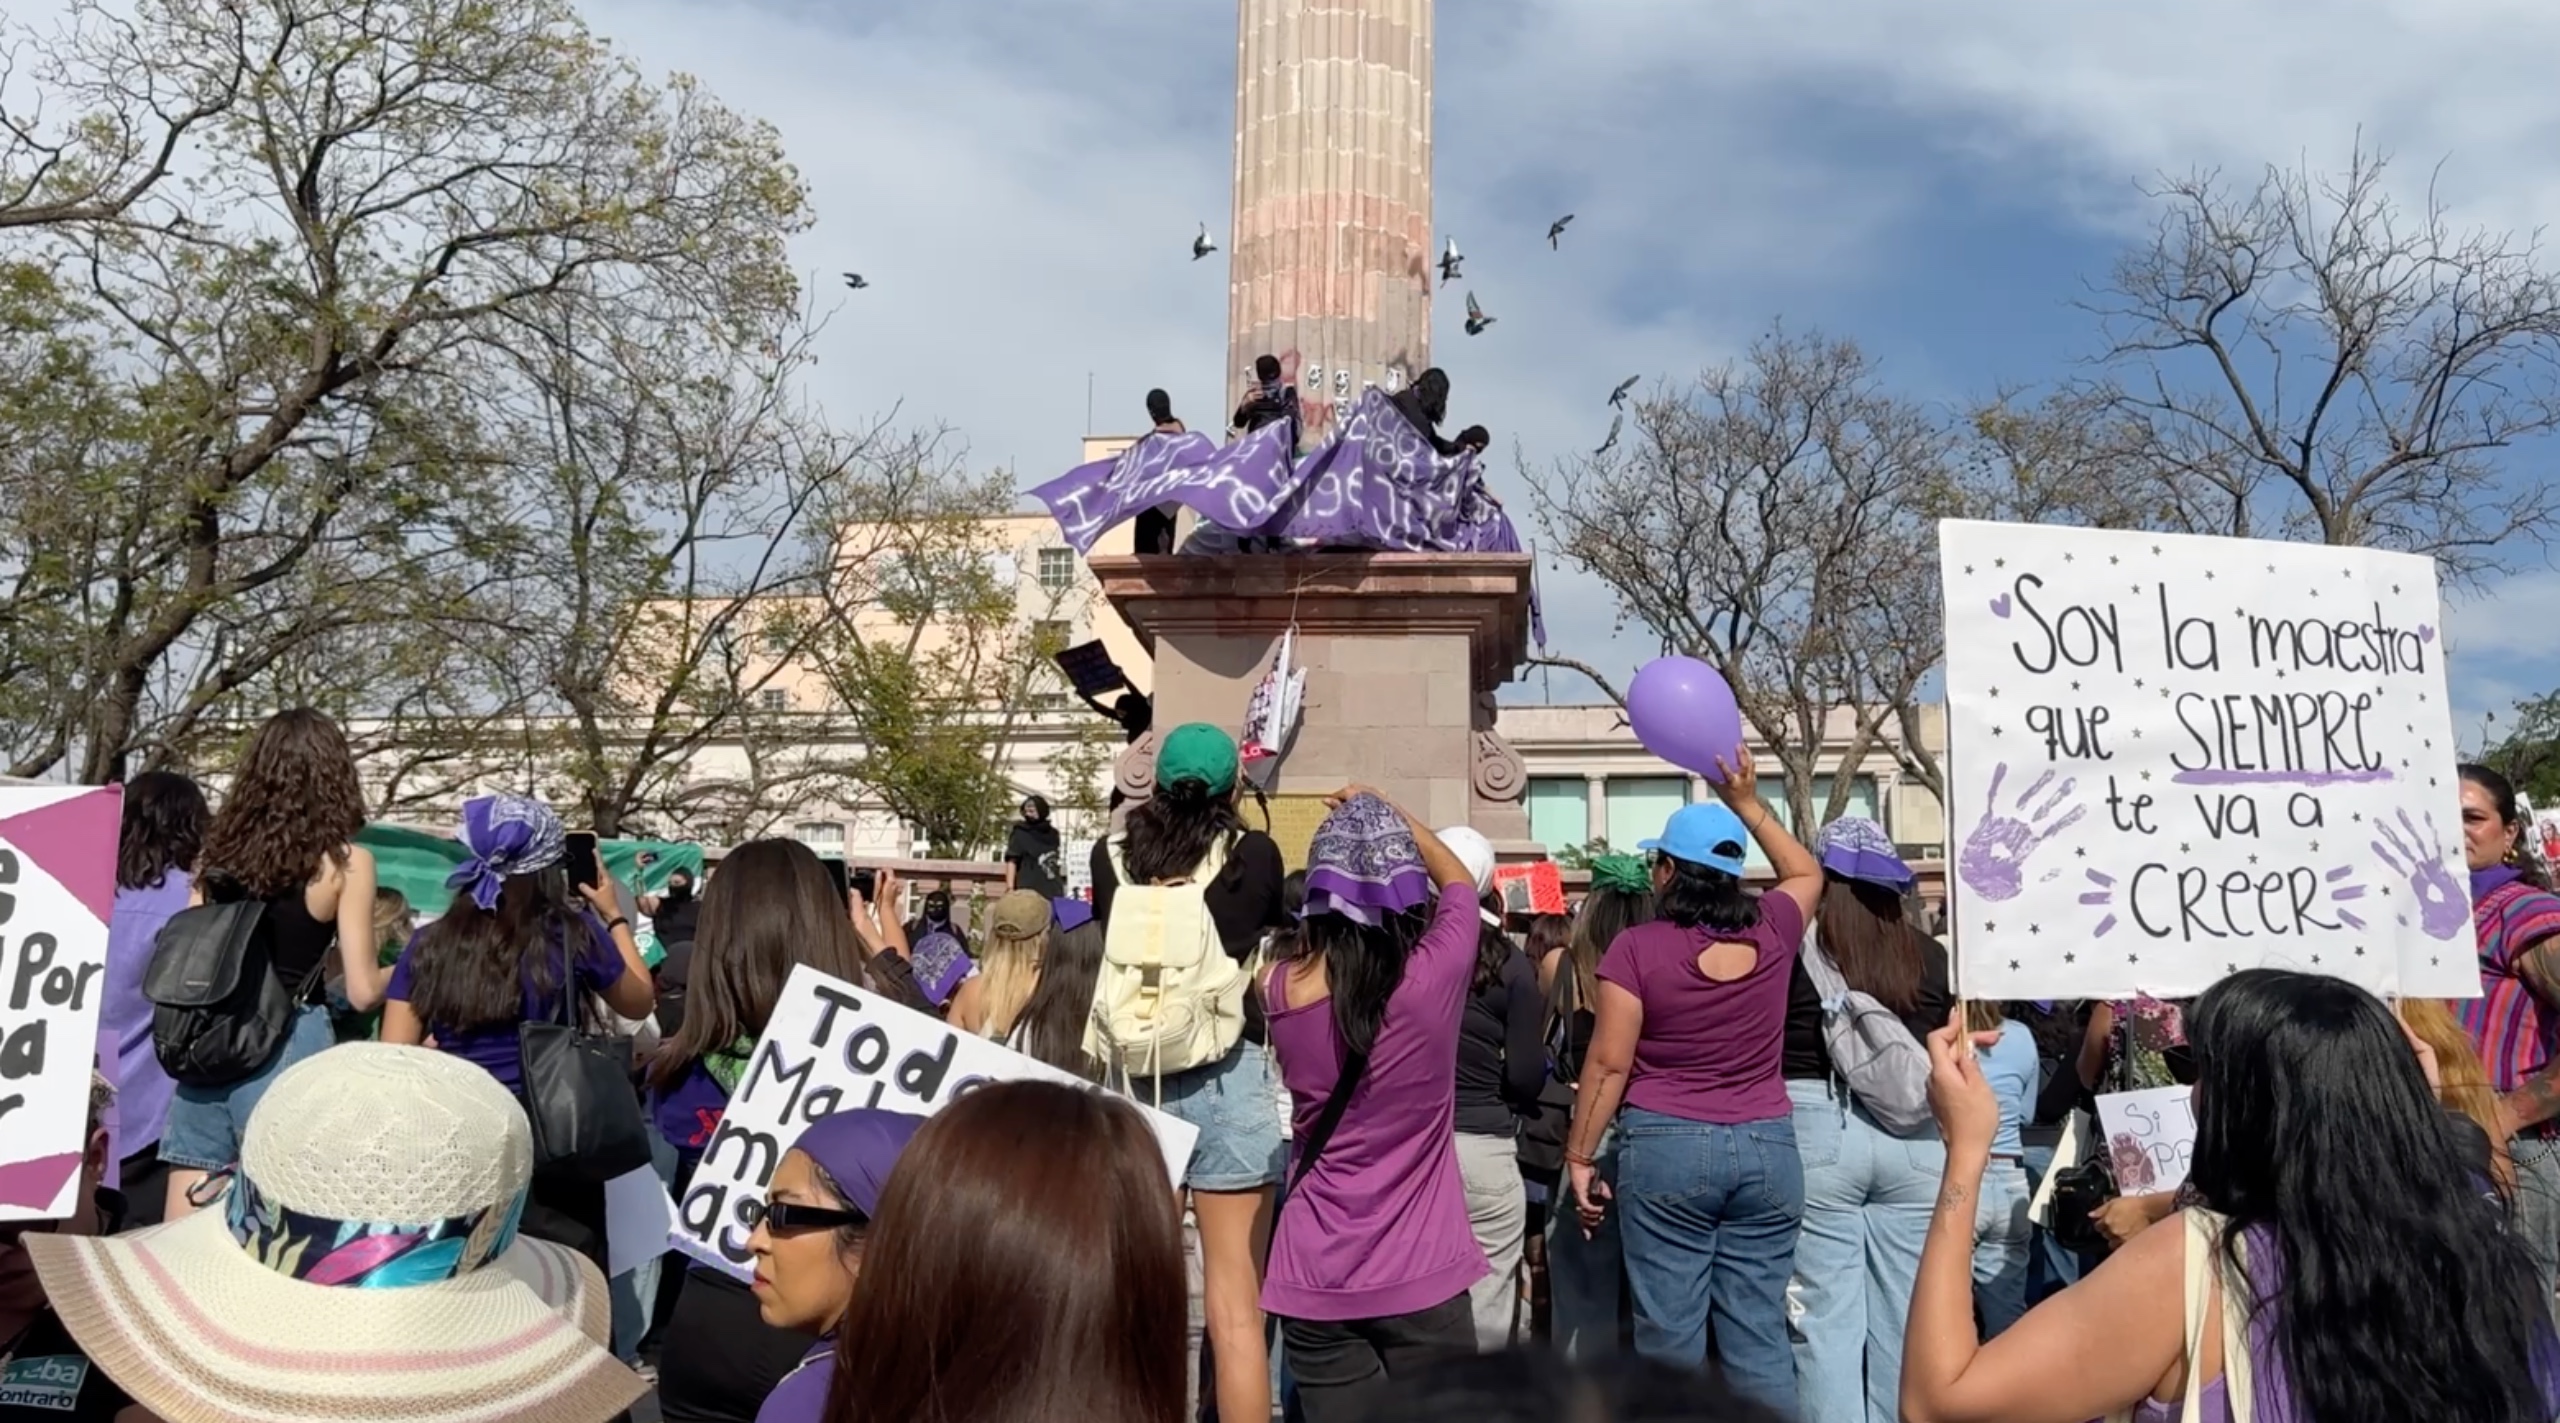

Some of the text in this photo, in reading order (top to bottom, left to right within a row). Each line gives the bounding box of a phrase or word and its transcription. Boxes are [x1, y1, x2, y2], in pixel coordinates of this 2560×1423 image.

[2012, 572, 2425, 676] Soy la maestra
[2026, 704, 2114, 762] que
[2106, 775, 2324, 839] te va a
[9, 931, 105, 1011] Por
[0, 1018, 48, 1080] a
[2125, 1102, 2161, 1136] Si
[0, 1388, 72, 1408] ontrario
